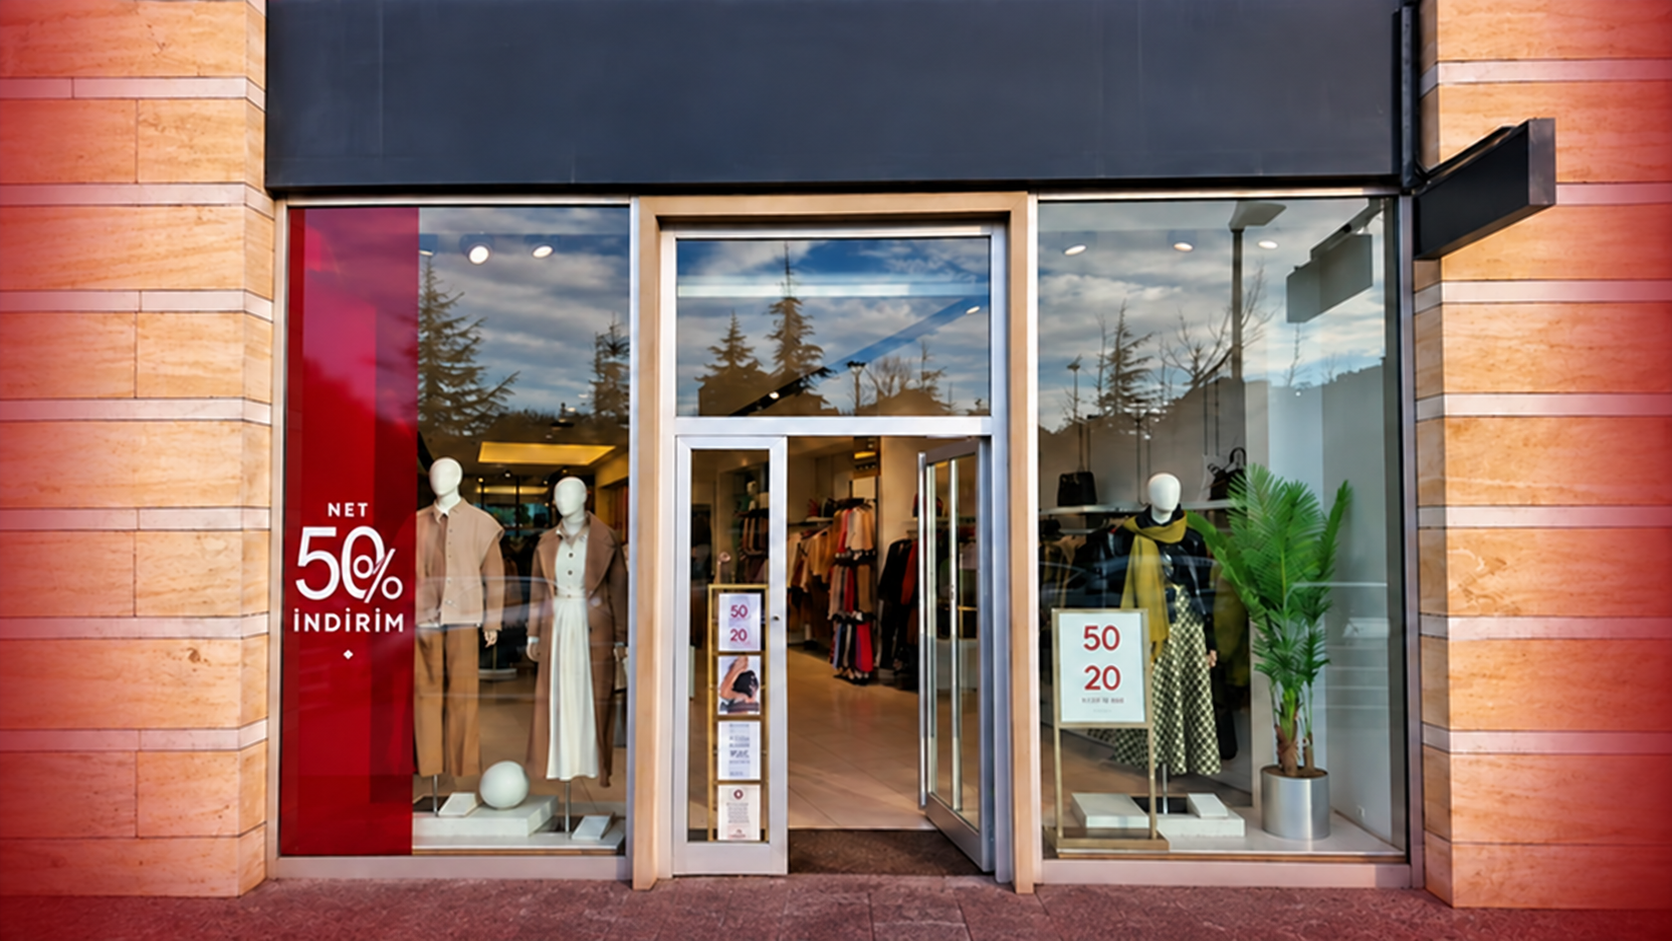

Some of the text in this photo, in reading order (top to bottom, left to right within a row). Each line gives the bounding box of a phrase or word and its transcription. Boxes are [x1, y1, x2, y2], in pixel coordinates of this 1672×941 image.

[327, 502, 369, 518] NET
[295, 525, 404, 604] 50%
[293, 607, 404, 633] İNDİRİM
[730, 604, 749, 619] 50
[729, 628, 748, 642] 20
[1083, 624, 1121, 652] 50
[1084, 664, 1122, 691] 20
